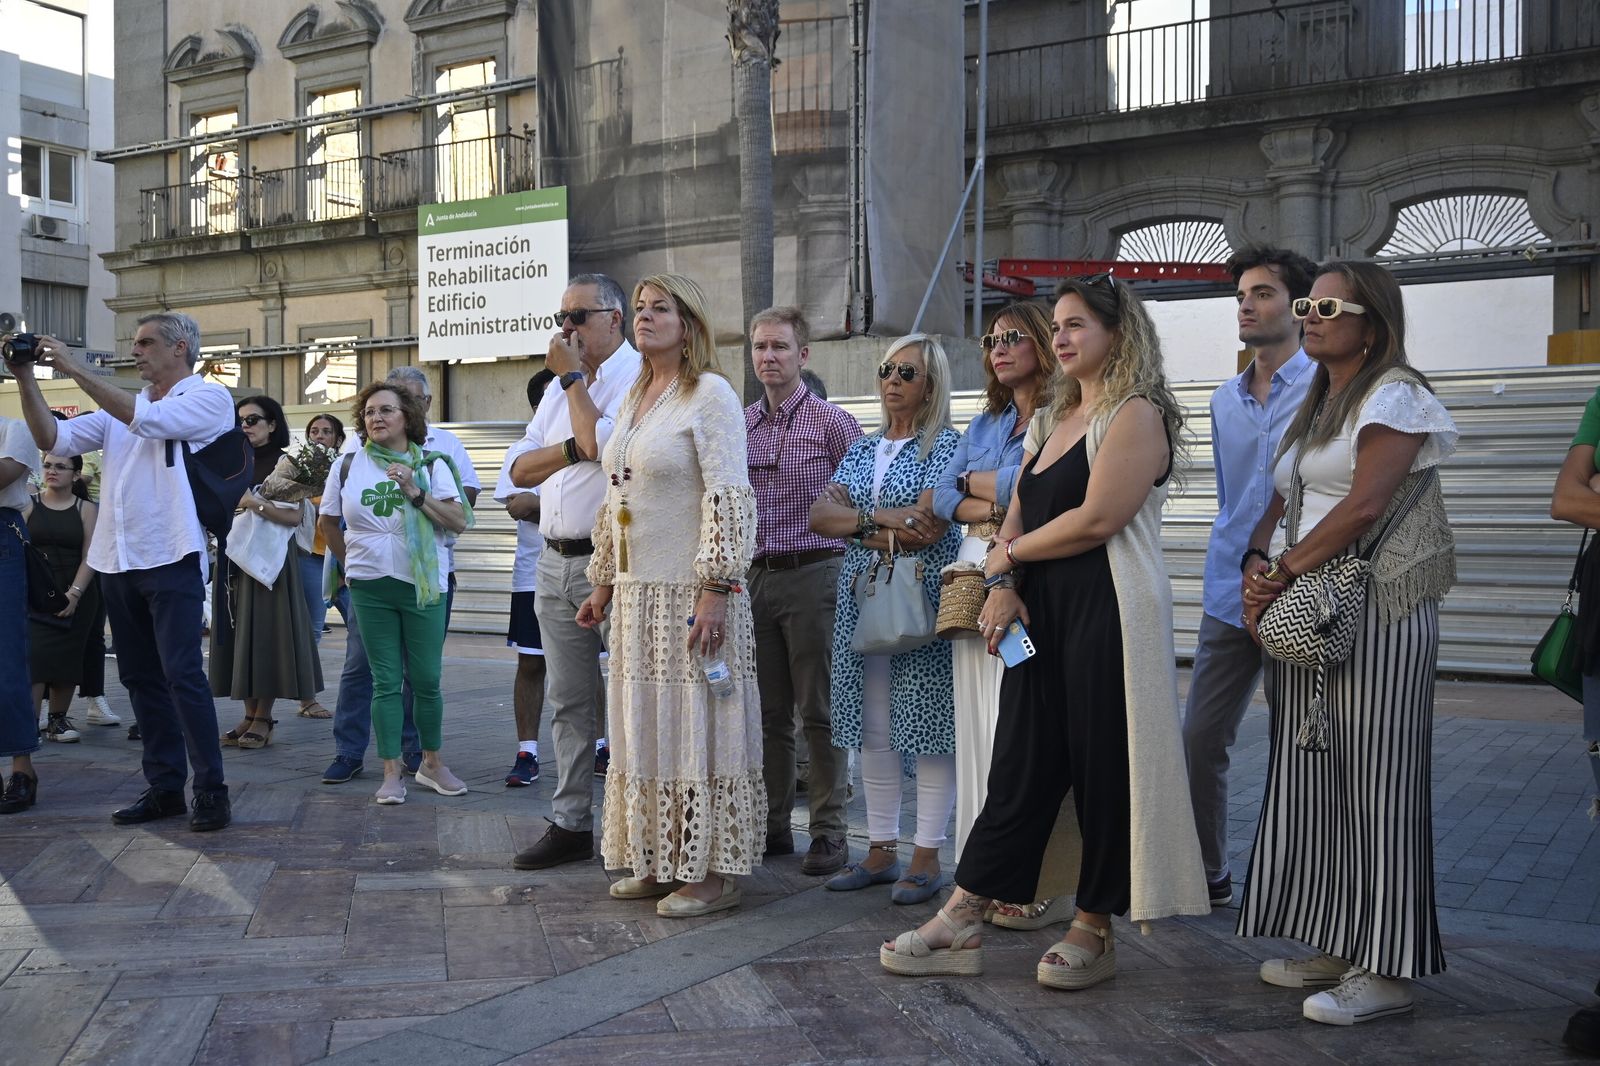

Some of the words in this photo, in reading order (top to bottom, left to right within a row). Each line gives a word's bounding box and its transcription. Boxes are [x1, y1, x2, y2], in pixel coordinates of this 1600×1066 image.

[455, 209, 477, 219] Andalucía
[427, 235, 531, 263] Terminación
[428, 259, 548, 288] Rehabilitación
[428, 291, 487, 313] Edificio
[427, 313, 553, 338] Administrativo
